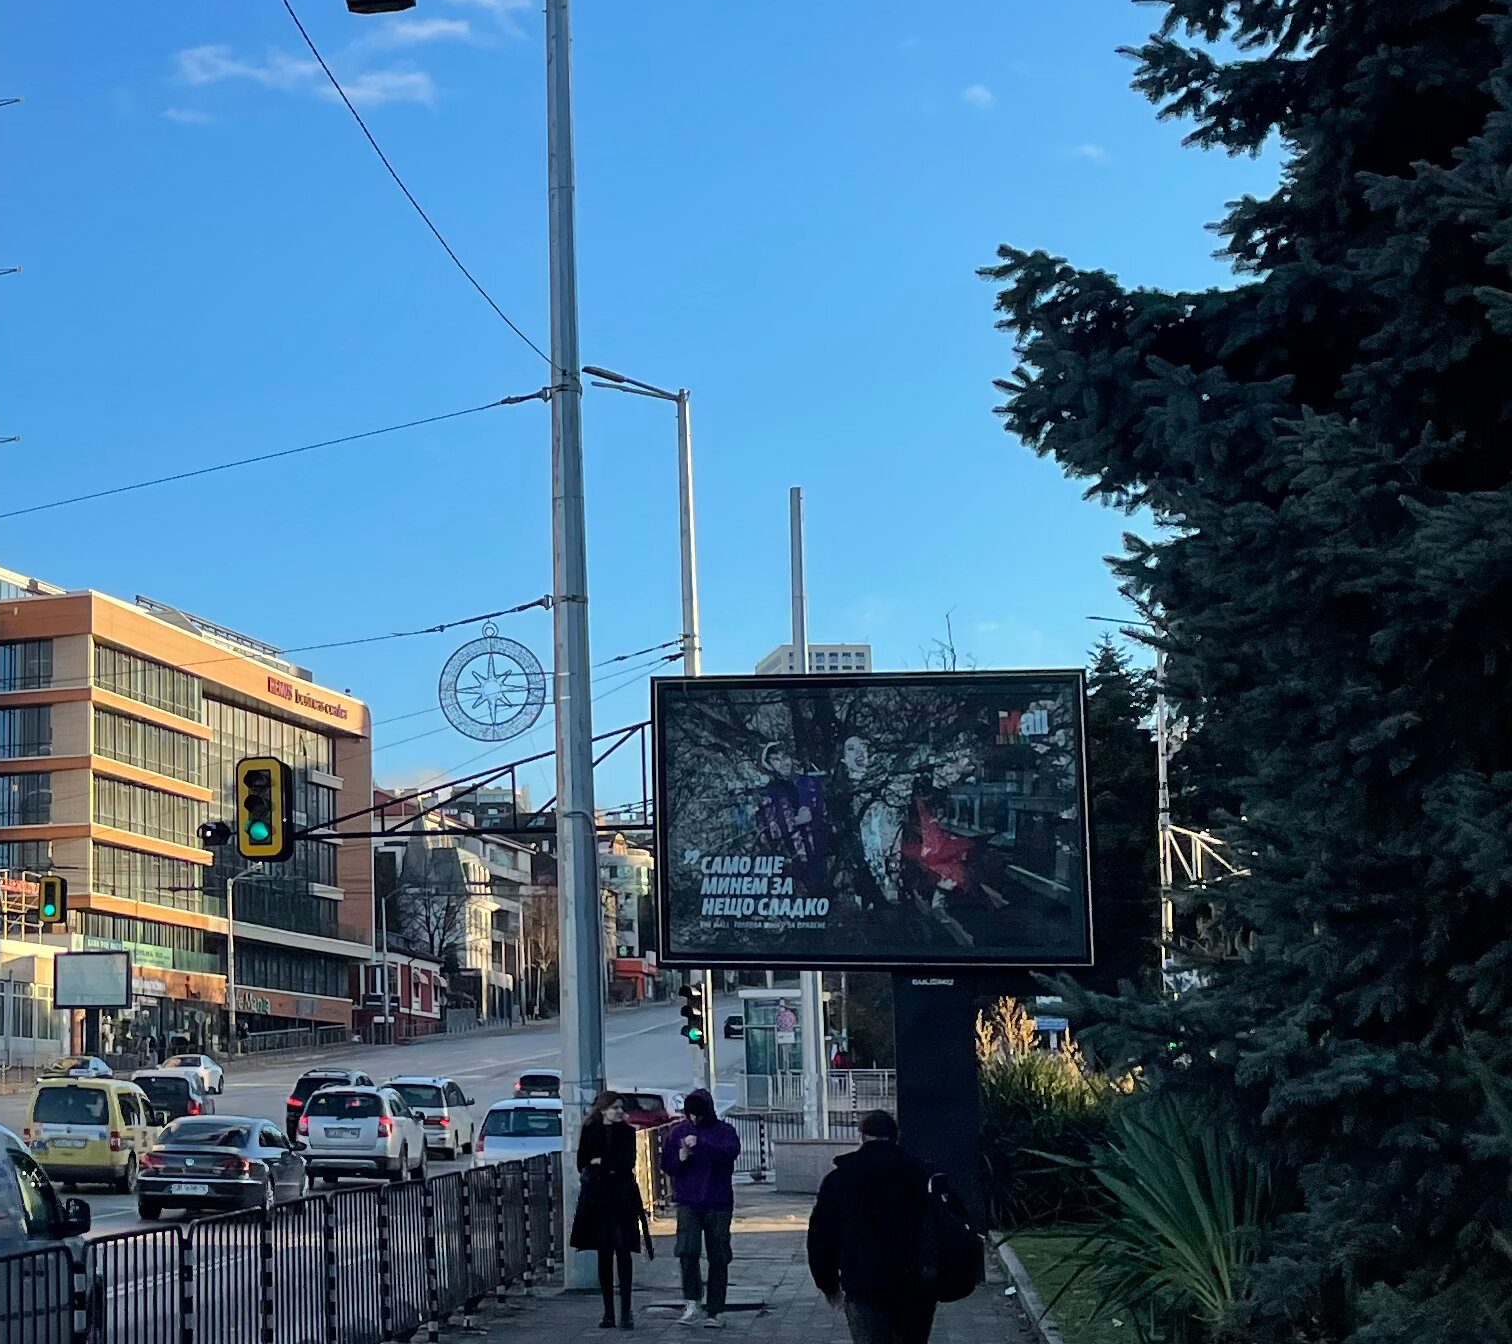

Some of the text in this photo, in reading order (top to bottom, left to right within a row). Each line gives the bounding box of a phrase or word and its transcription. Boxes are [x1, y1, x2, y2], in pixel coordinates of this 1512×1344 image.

[295, 689, 325, 712] business
[700, 856, 785, 877] САМО ЩЕ
[700, 877, 793, 895] МИНЕМ ЗА
[701, 898, 830, 918] НЕЩО СЛАДКО
